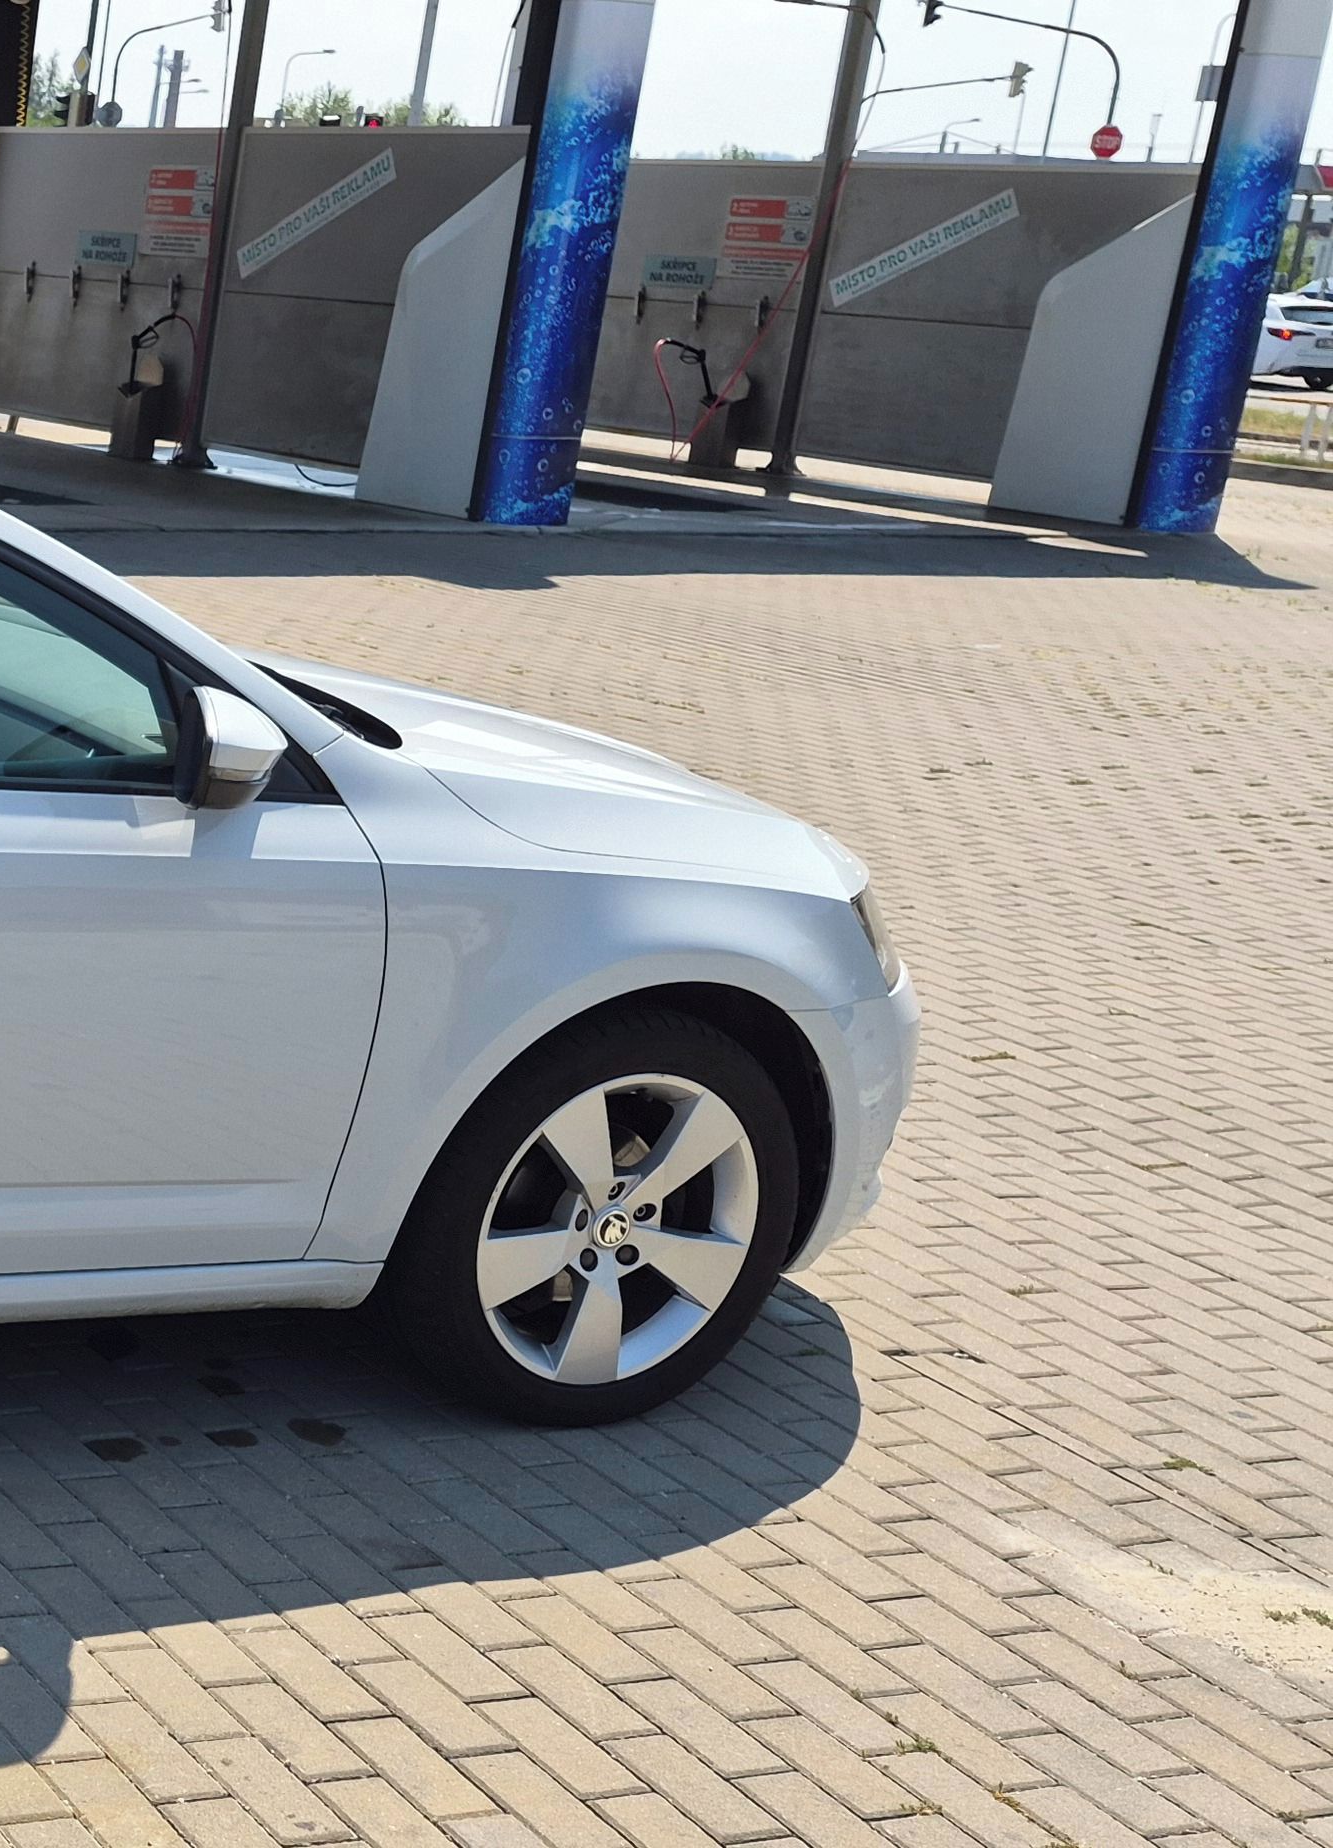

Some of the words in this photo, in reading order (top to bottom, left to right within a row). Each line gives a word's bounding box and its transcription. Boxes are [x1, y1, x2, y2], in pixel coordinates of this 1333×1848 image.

[241, 233, 276, 266] MÍSTO
[277, 216, 303, 240] PRO
[332, 156, 391, 205] REKLAMU
[834, 265, 876, 296] MÍSTO
[879, 250, 907, 273] PRO
[908, 230, 941, 257] VAŠI
[943, 194, 1013, 241] REKLAMU
[649, 271, 662, 282] NA
